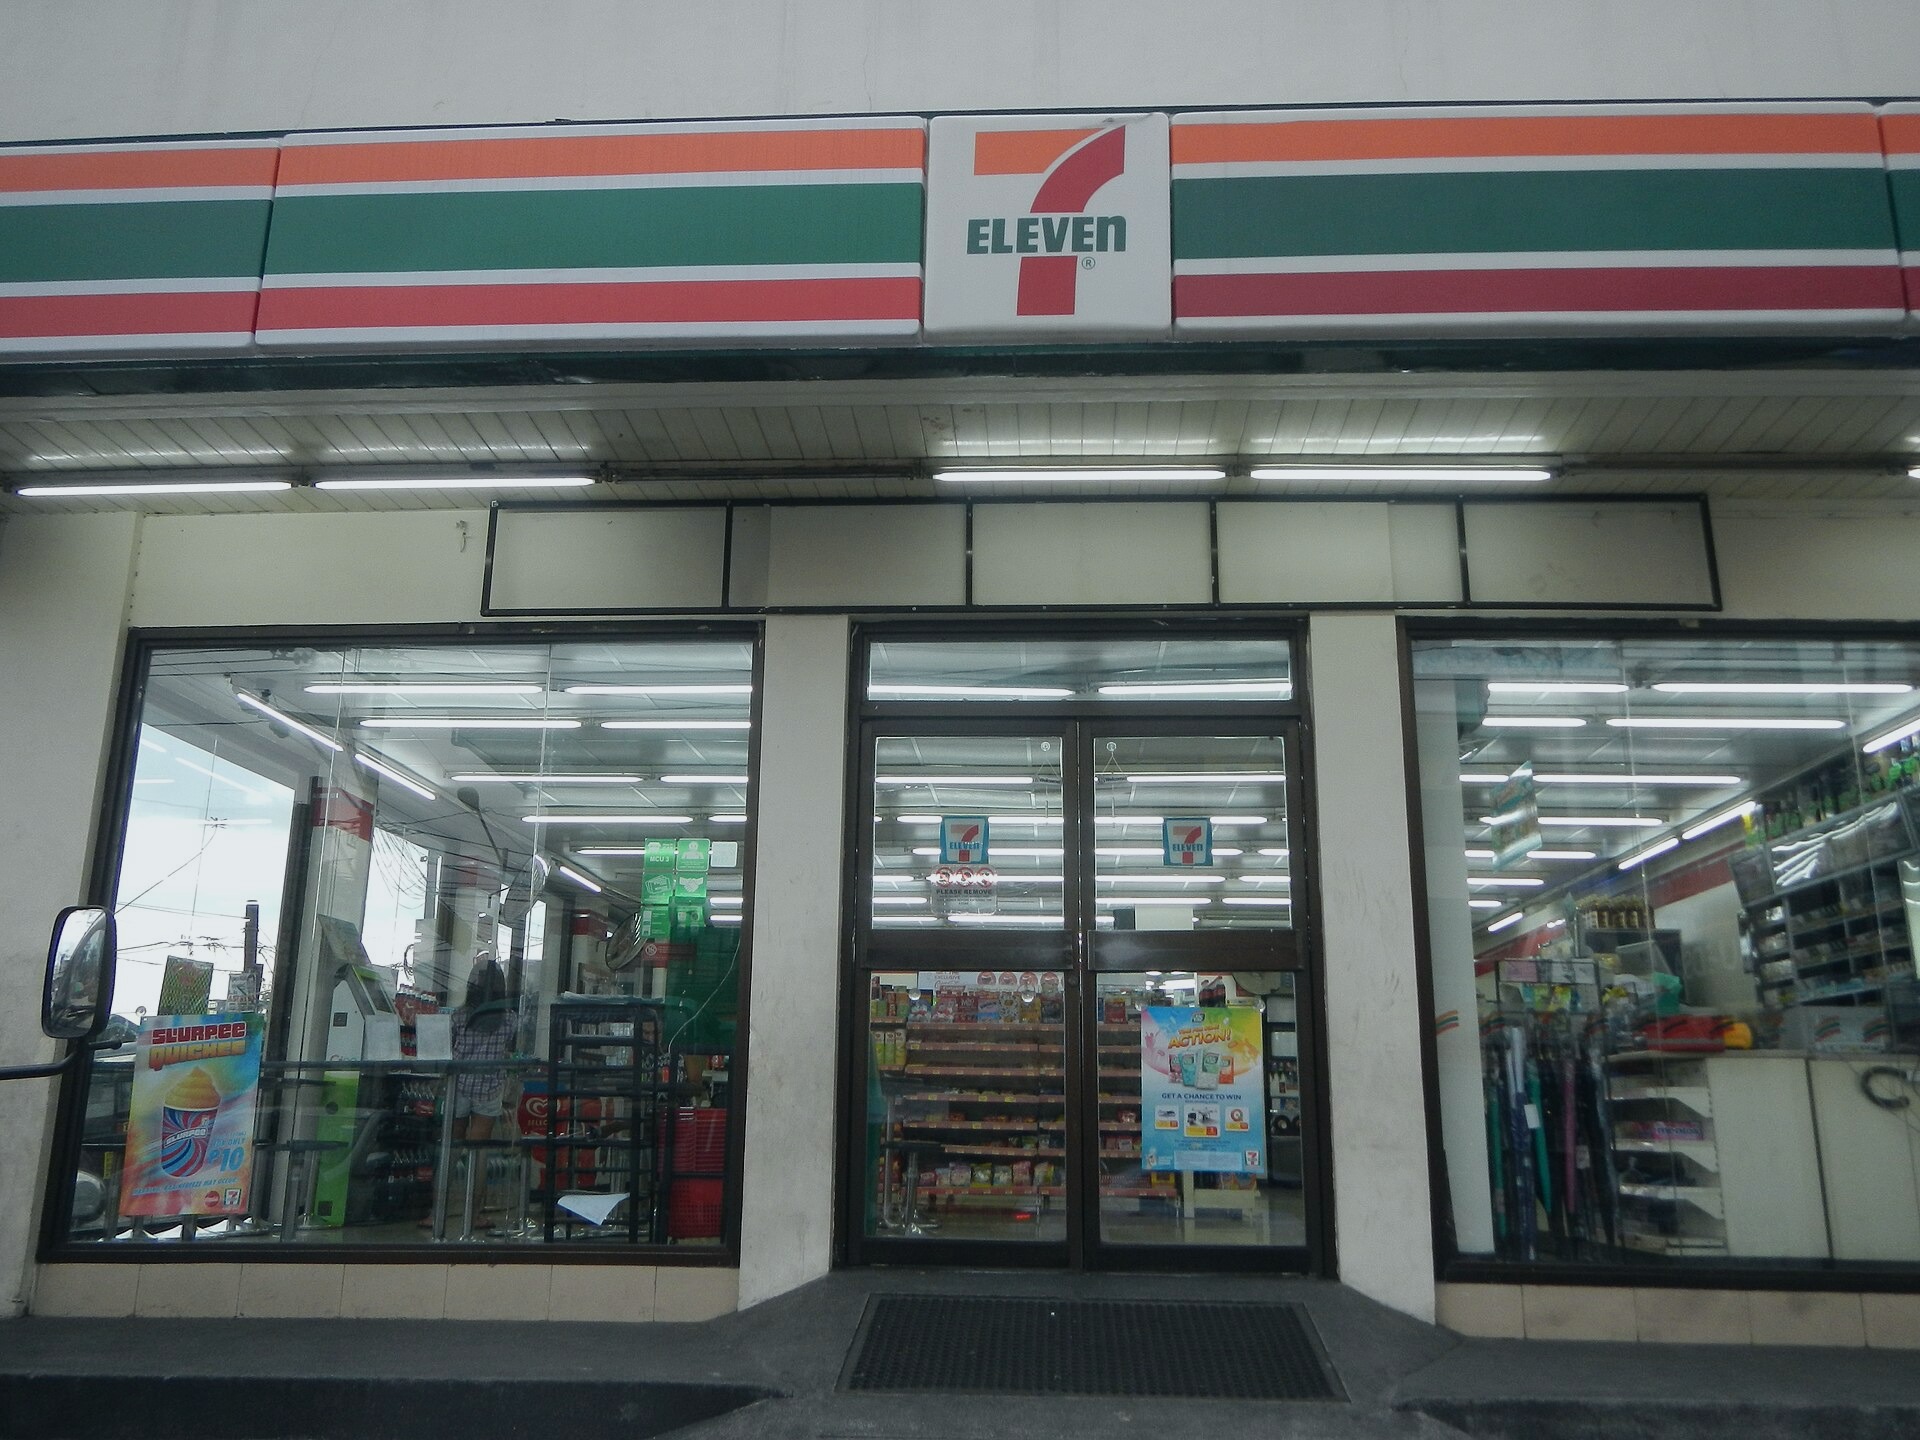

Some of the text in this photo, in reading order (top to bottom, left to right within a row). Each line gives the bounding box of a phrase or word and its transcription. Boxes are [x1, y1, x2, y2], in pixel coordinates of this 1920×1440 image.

[966, 215, 1127, 254] ELEVEn
[974, 125, 1126, 316] 7
[950, 824, 979, 862] 7
[1172, 826, 1202, 864] 7
[152, 1022, 247, 1045] SLURPEE
[1168, 1029, 1232, 1049] ACTION!
